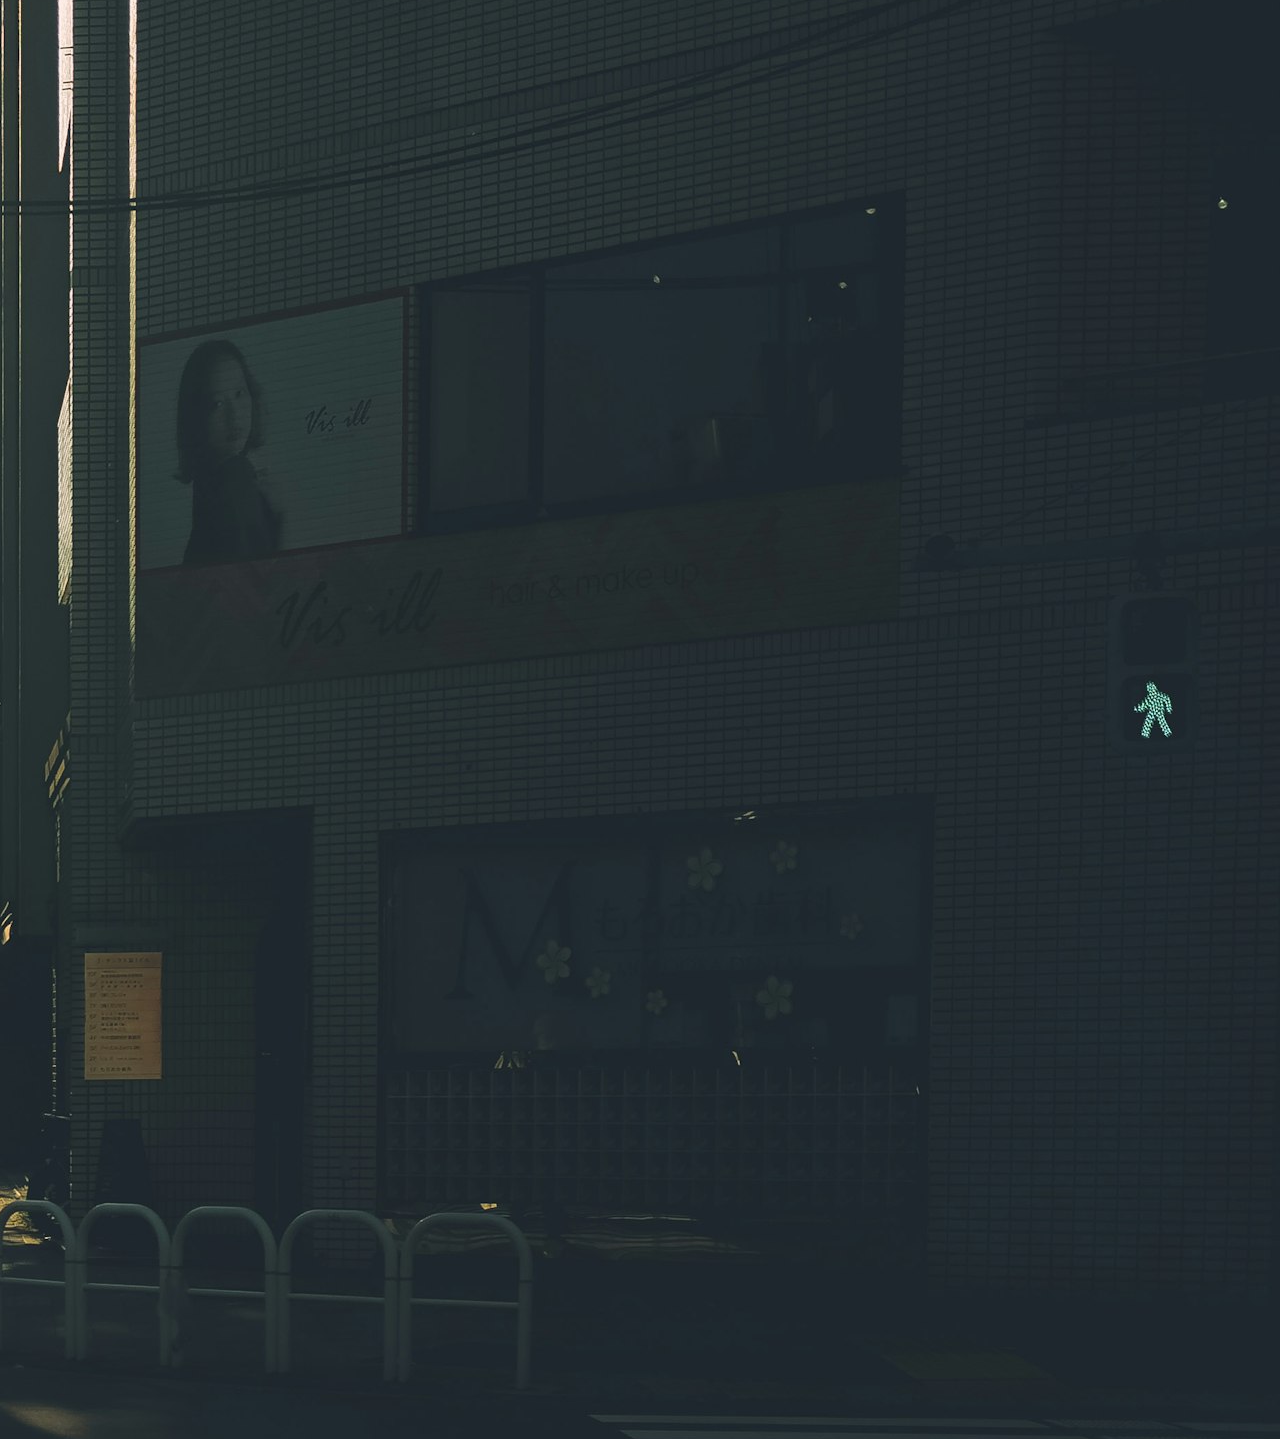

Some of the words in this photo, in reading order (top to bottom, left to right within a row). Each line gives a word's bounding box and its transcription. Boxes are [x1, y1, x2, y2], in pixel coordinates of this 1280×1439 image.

[305, 406, 337, 434] Vis
[343, 398, 372, 428] ill
[275, 579, 353, 649] Vis
[369, 567, 444, 636] ill
[489, 578, 537, 607] hair
[547, 575, 571, 600] &
[576, 566, 654, 595] make
[663, 561, 700, 589] up
[443, 859, 588, 1000] M
[597, 886, 834, 941] もろおか歯科
